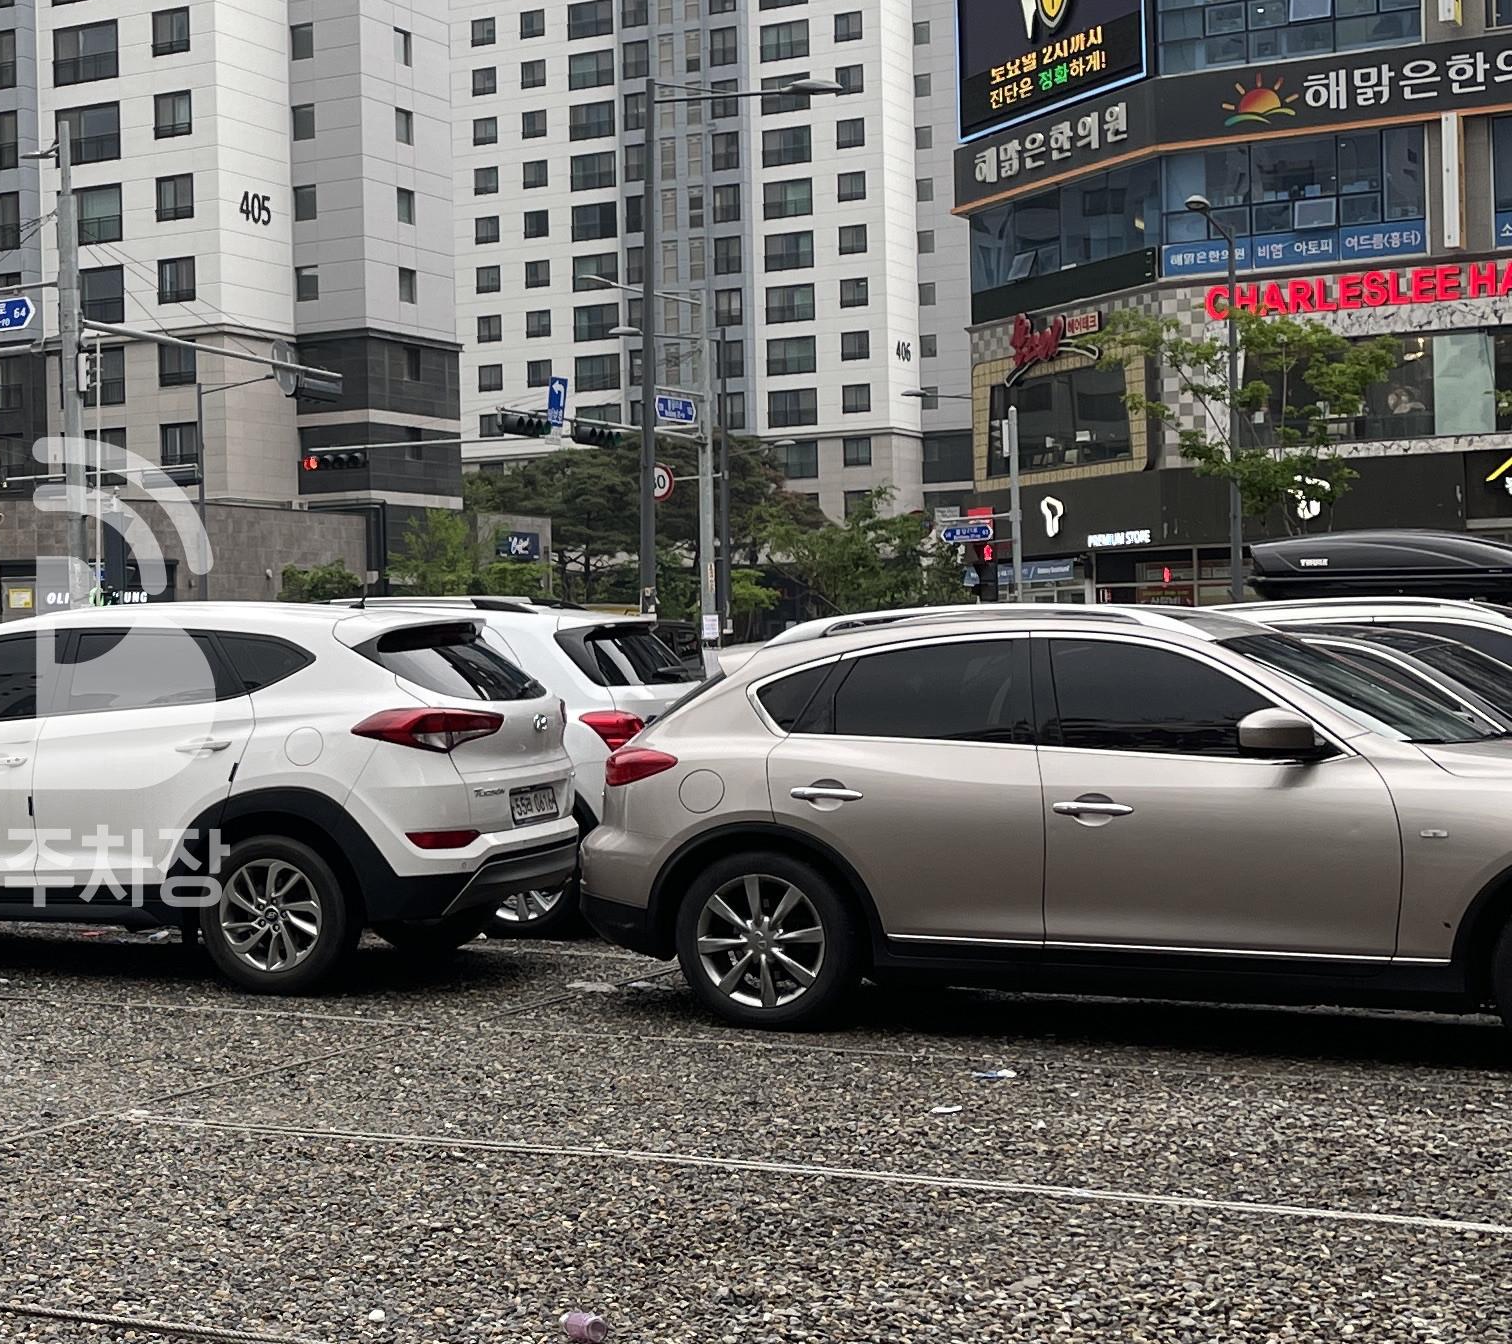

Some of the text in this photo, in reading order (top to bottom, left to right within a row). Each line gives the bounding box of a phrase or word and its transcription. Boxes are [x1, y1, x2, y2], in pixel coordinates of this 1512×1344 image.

[990, 77, 1035, 110] 진단은
[239, 190, 271, 225] 405
[1294, 239, 1333, 256] 아토피
[1204, 264, 1461, 322] CHARLESLEE
[13, 307, 26, 319] 64
[896, 340, 911, 362] 406
